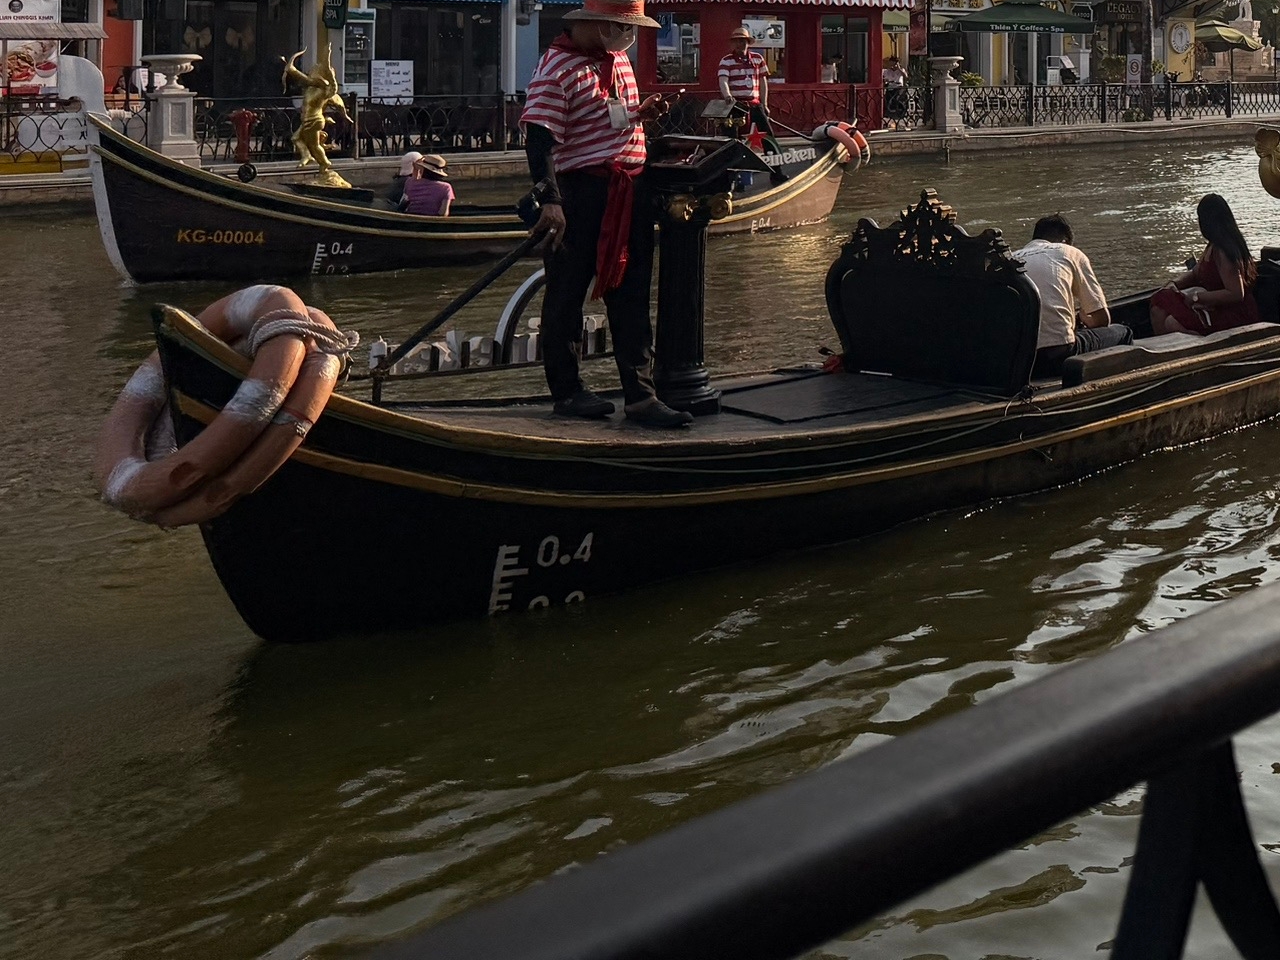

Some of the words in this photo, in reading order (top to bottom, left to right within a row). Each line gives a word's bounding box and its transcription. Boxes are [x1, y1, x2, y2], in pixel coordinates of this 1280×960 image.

[756, 147, 817, 167] eineken
[177, 229, 265, 244] KG-00004
[331, 242, 353, 255] 0.4
[537, 532, 594, 568] 0.4
